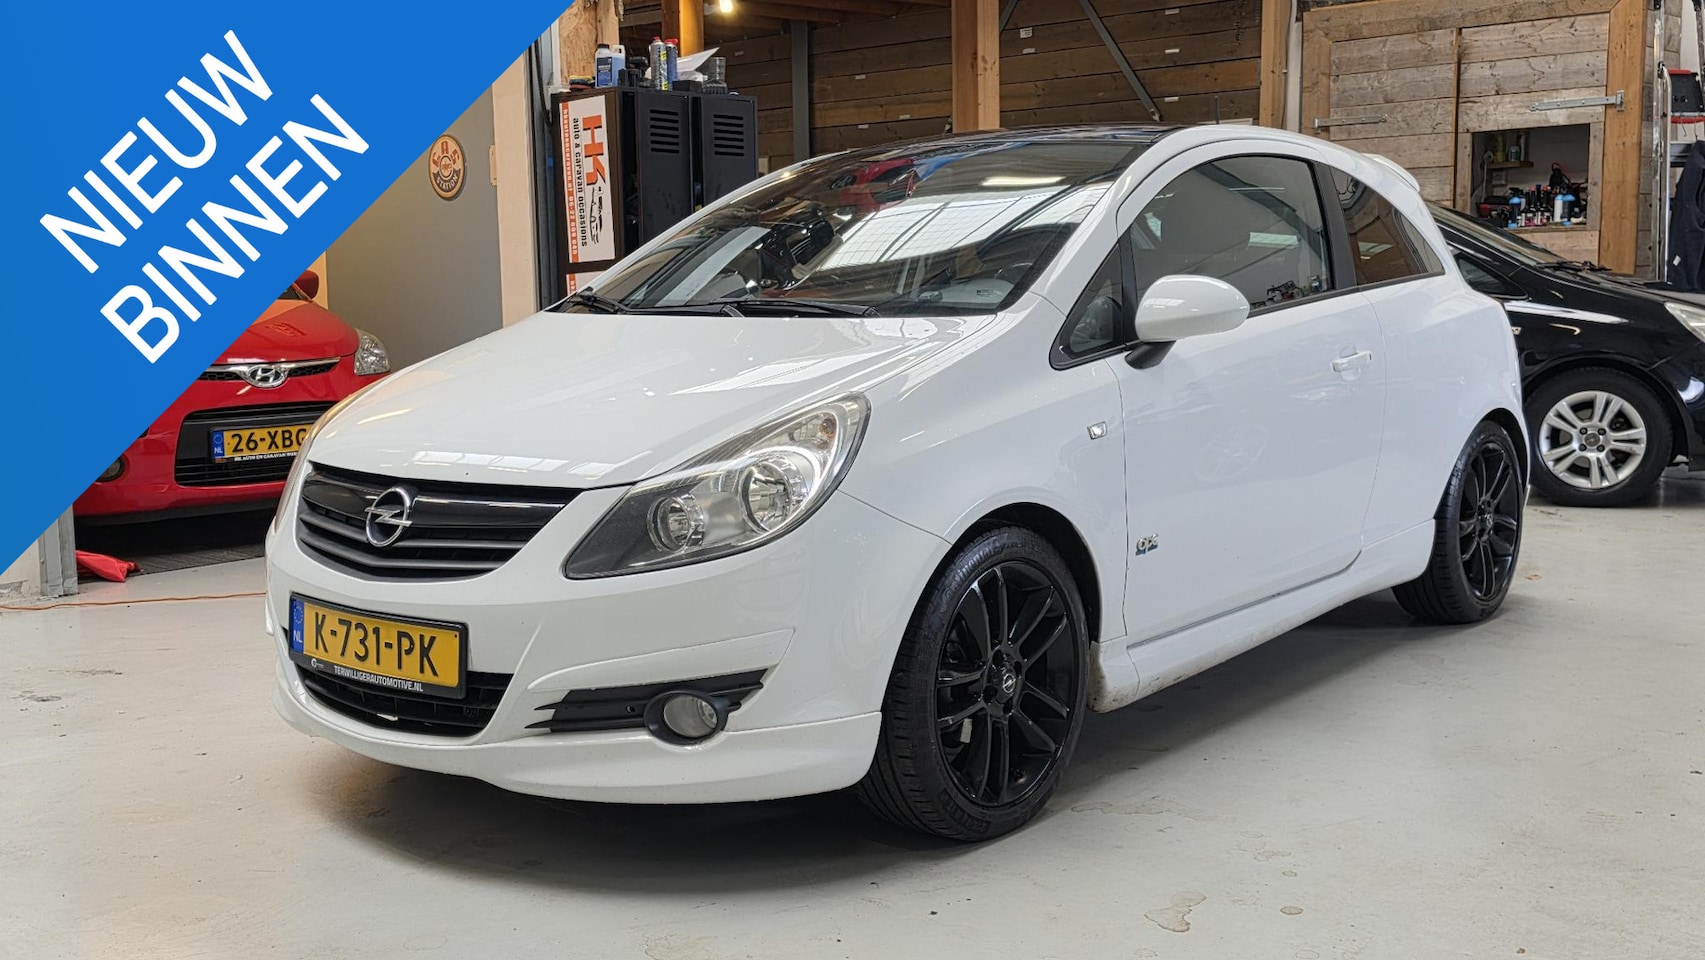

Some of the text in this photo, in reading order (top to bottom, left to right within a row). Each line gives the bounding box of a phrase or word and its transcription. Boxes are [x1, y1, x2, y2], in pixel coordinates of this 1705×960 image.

[573, 117, 581, 140] auto
[582, 115, 606, 186] HK
[436, 173, 459, 190] STATION
[575, 152, 583, 193] caravan
[578, 196, 588, 247] occasions
[231, 429, 306, 453] 26-XBG
[293, 630, 303, 643] NL
[315, 611, 439, 677] K-731-PK
[333, 665, 424, 692] TERWILLIGERAUTOMOTIVE.NL
